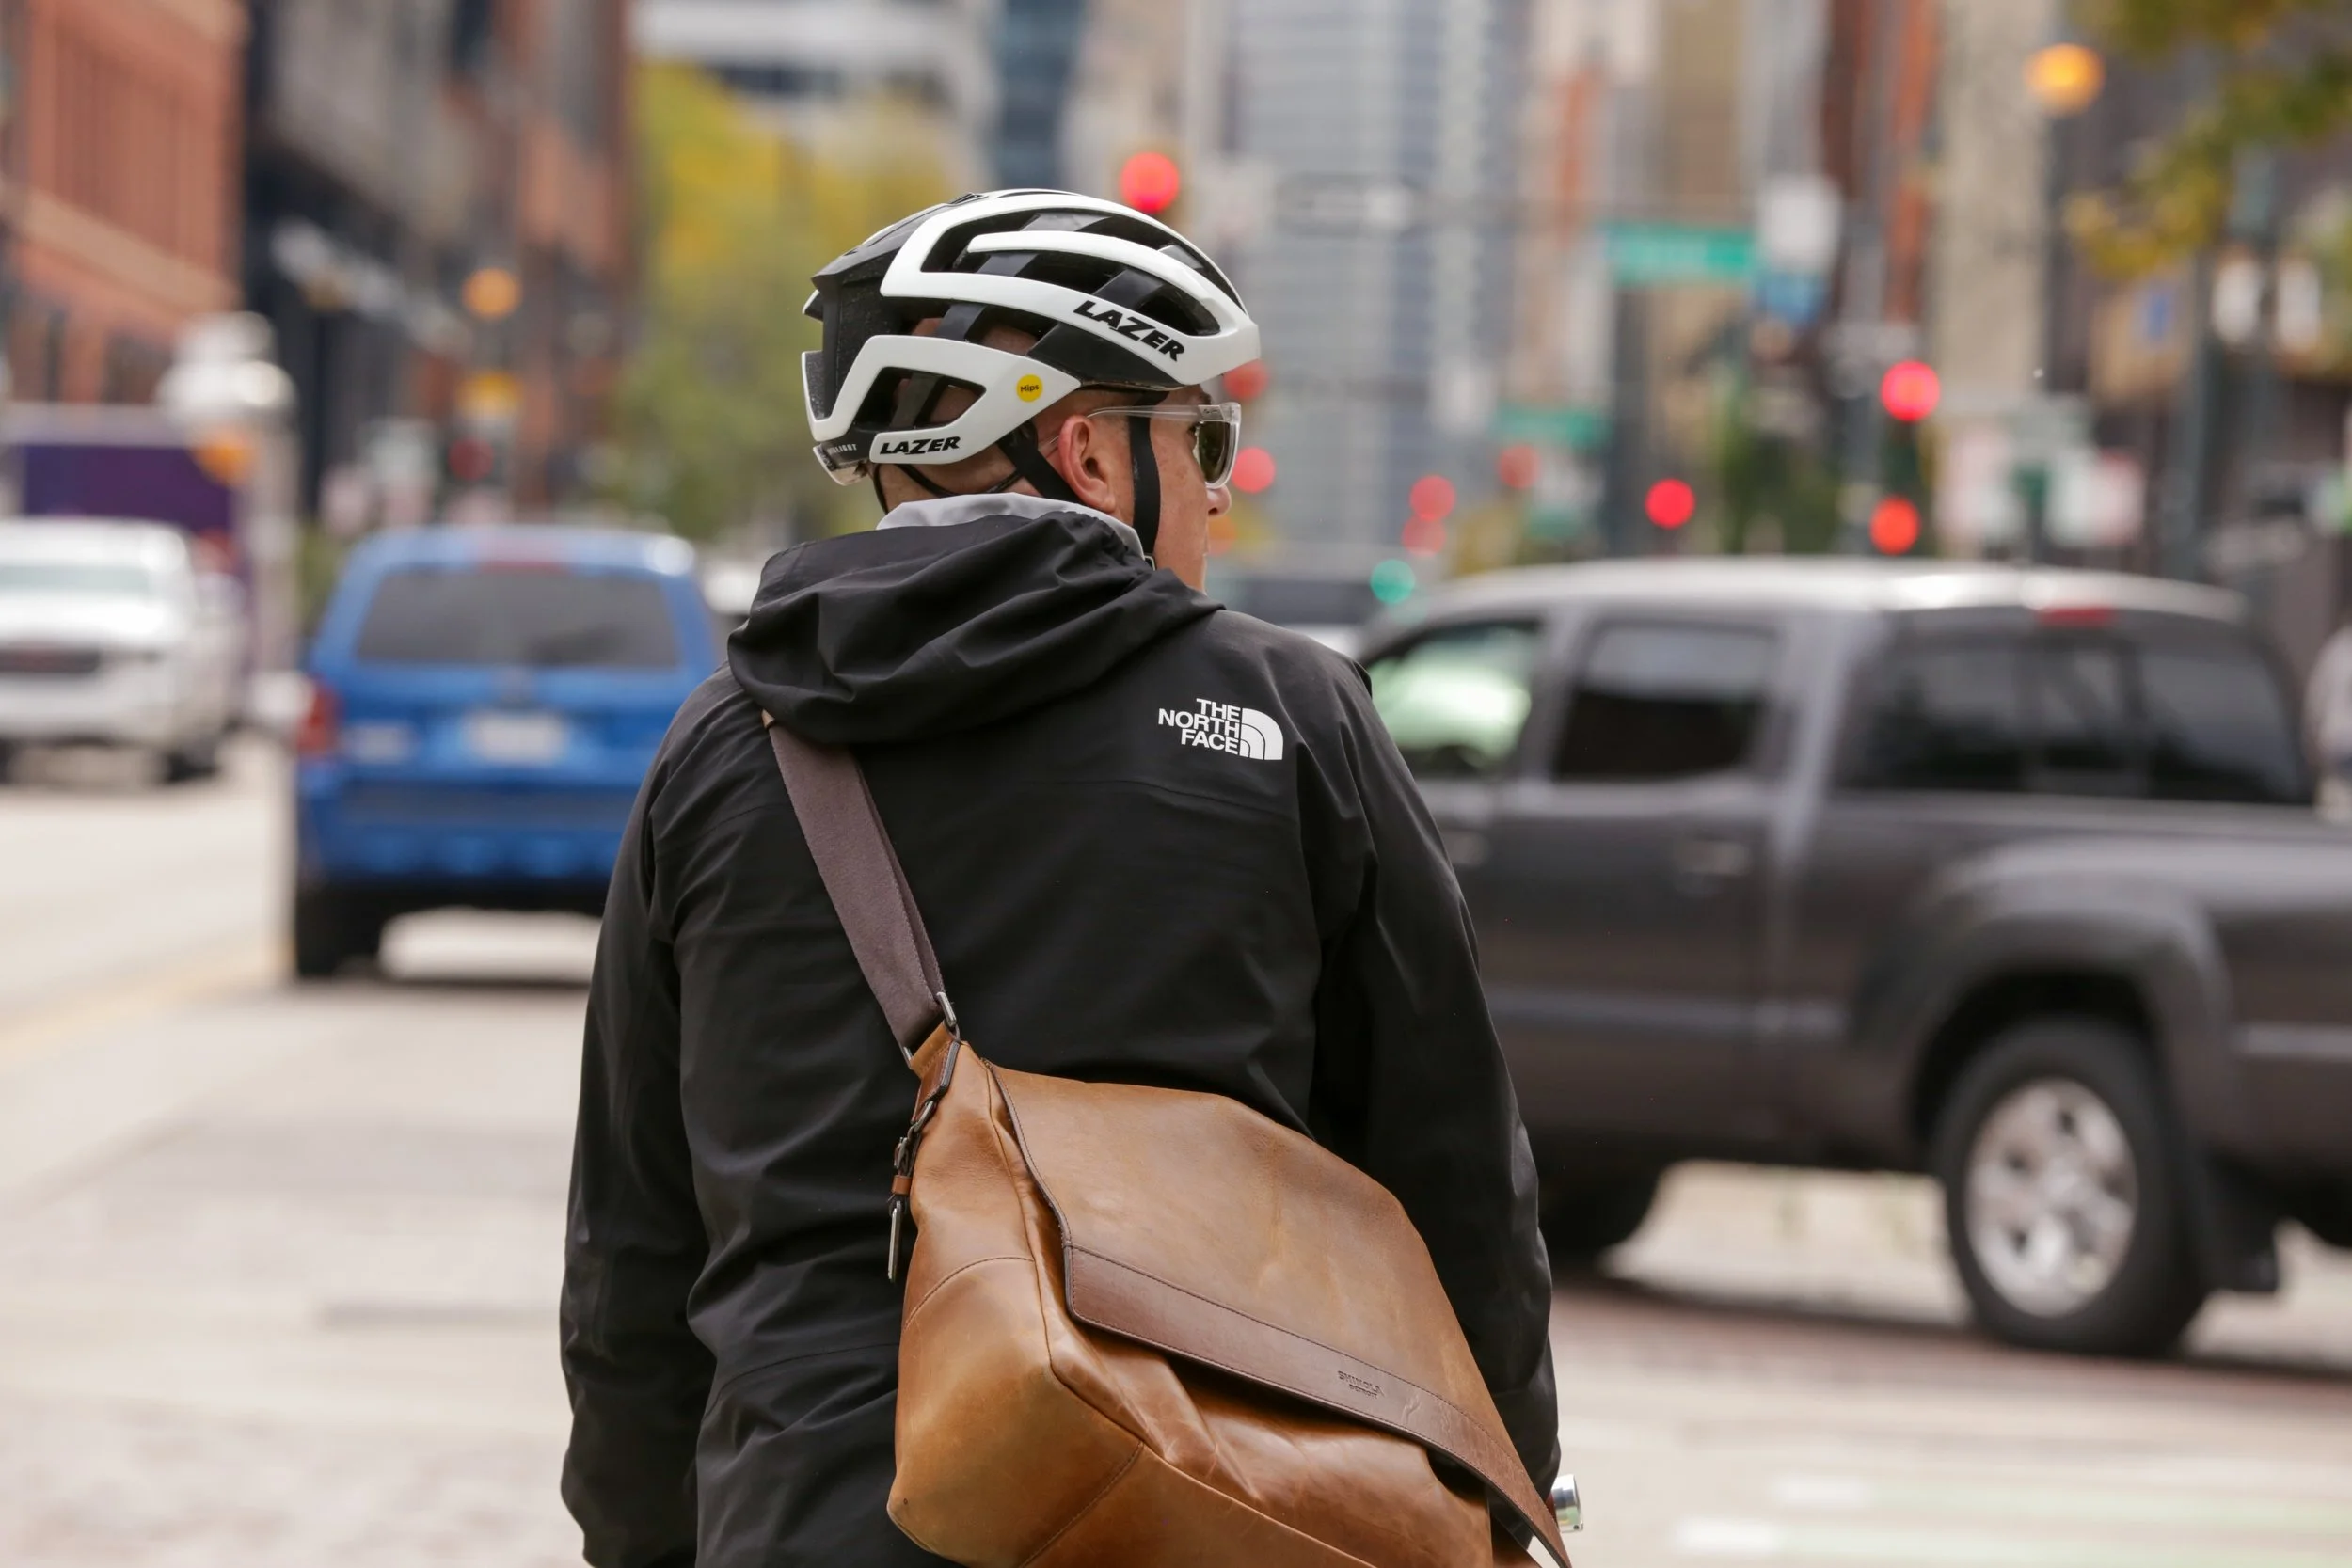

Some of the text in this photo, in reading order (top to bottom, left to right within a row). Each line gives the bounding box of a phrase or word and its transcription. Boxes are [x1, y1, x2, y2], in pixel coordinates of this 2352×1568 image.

[1073, 300, 1184, 362] LAZER
[880, 436, 961, 455] LAZER
[1158, 708, 1240, 739] NORTH
[1196, 698, 1241, 723] THE
[1181, 728, 1239, 755] FACE
